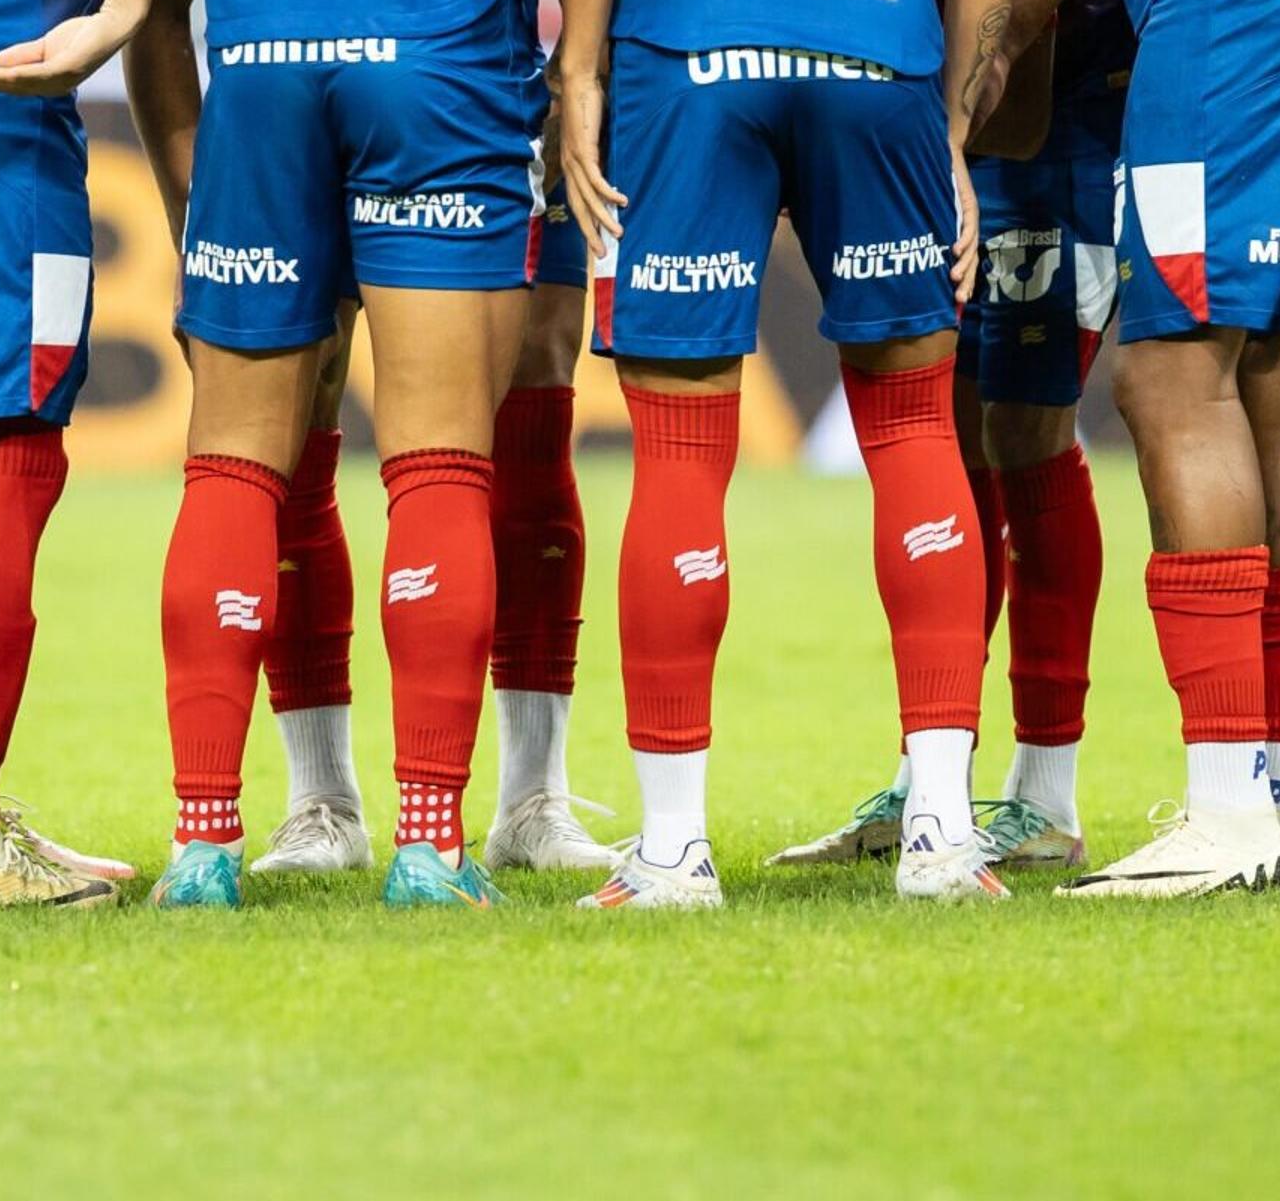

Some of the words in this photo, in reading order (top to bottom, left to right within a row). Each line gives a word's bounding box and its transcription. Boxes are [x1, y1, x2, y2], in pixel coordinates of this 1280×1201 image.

[354, 197, 486, 229] MULTIVIX
[645, 251, 740, 269] FACULDADE
[843, 233, 934, 257] FACULDADE
[186, 252, 300, 285] MULTIVIX
[631, 261, 757, 293] MULTIVIX
[832, 244, 949, 280] MULTIVIX
